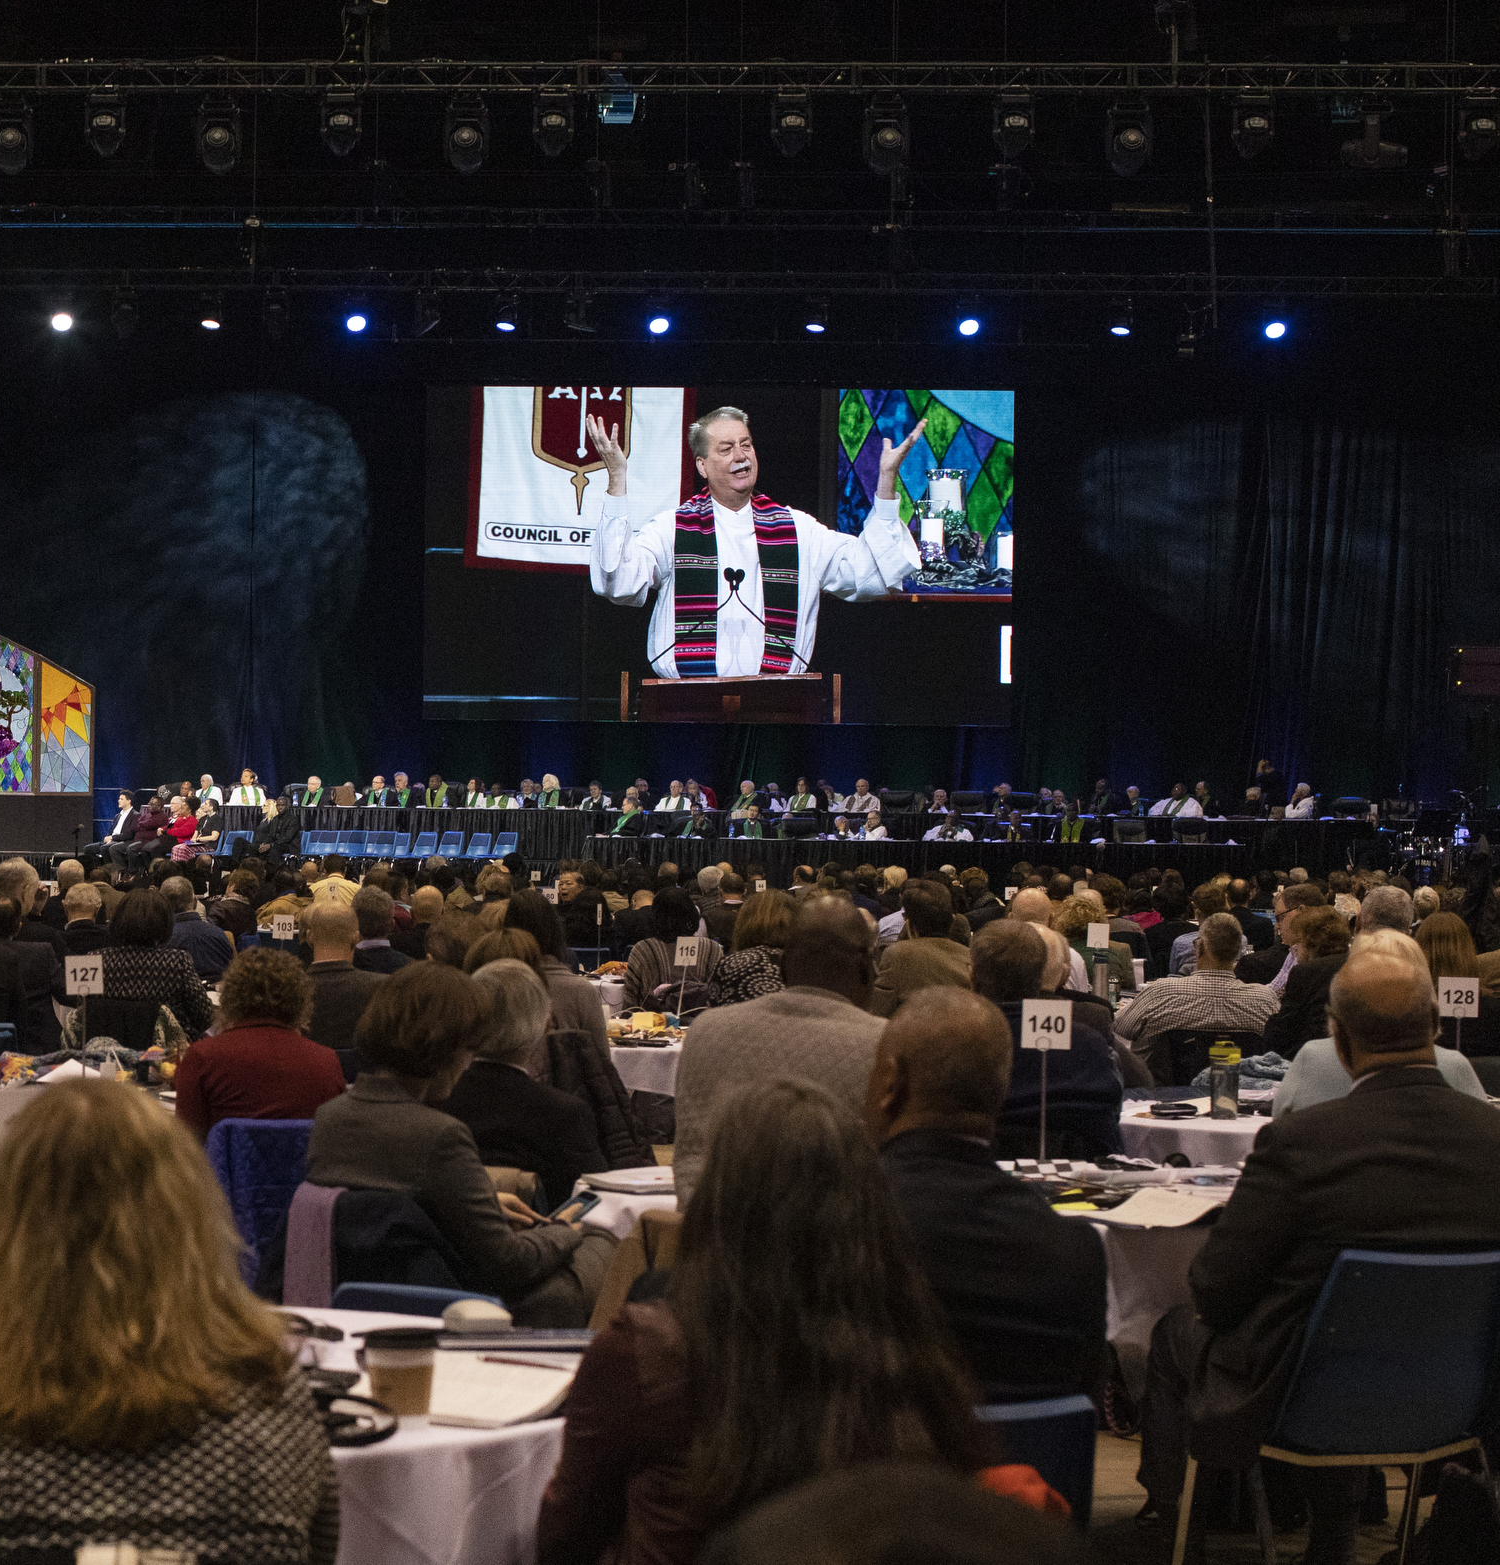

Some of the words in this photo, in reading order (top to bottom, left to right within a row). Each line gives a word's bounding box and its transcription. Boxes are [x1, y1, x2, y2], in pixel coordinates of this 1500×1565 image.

[491, 525, 562, 542] COUNCIL
[569, 531, 591, 543] OF
[276, 922, 293, 931] 103
[679, 946, 696, 957] 116
[70, 967, 98, 981] 127
[1443, 990, 1475, 1004] 128
[1028, 1014, 1066, 1034] 140
